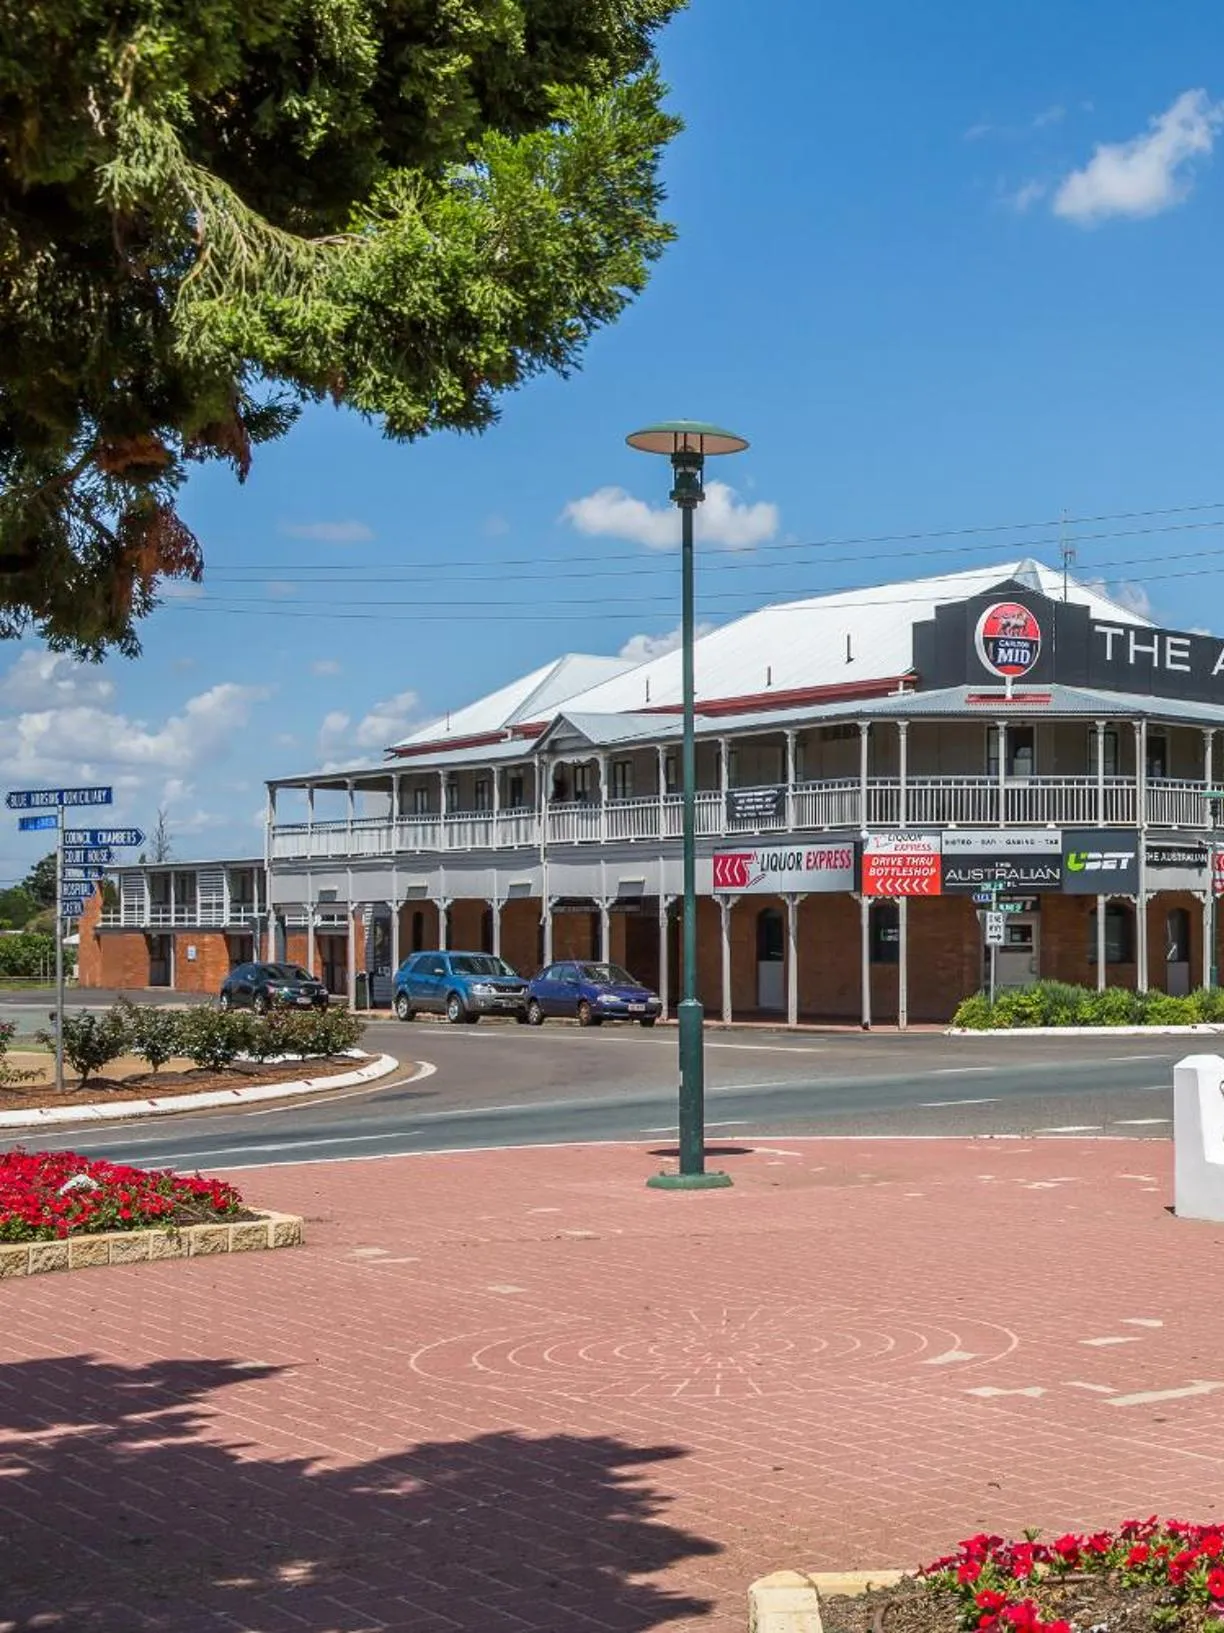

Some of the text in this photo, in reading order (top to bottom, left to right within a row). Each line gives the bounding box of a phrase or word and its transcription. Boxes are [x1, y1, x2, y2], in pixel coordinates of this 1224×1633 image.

[1094, 624, 1191, 673] THE
[996, 647, 1030, 665] MID
[10, 793, 27, 808] BLUE
[64, 831, 137, 845] COUNCIL CHAMBERS
[894, 842, 932, 851] EXPRESS
[64, 848, 109, 863] COURT HOUSE
[760, 849, 853, 873] LIQUOR EXPRESS
[871, 856, 935, 866] DRIVE THRU
[1067, 851, 1135, 872] UBET
[1145, 852, 1208, 863] THE AUSTRALIAN
[869, 866, 937, 877] BOTTLESHOP
[945, 868, 1060, 881] AUSTRALIAN
